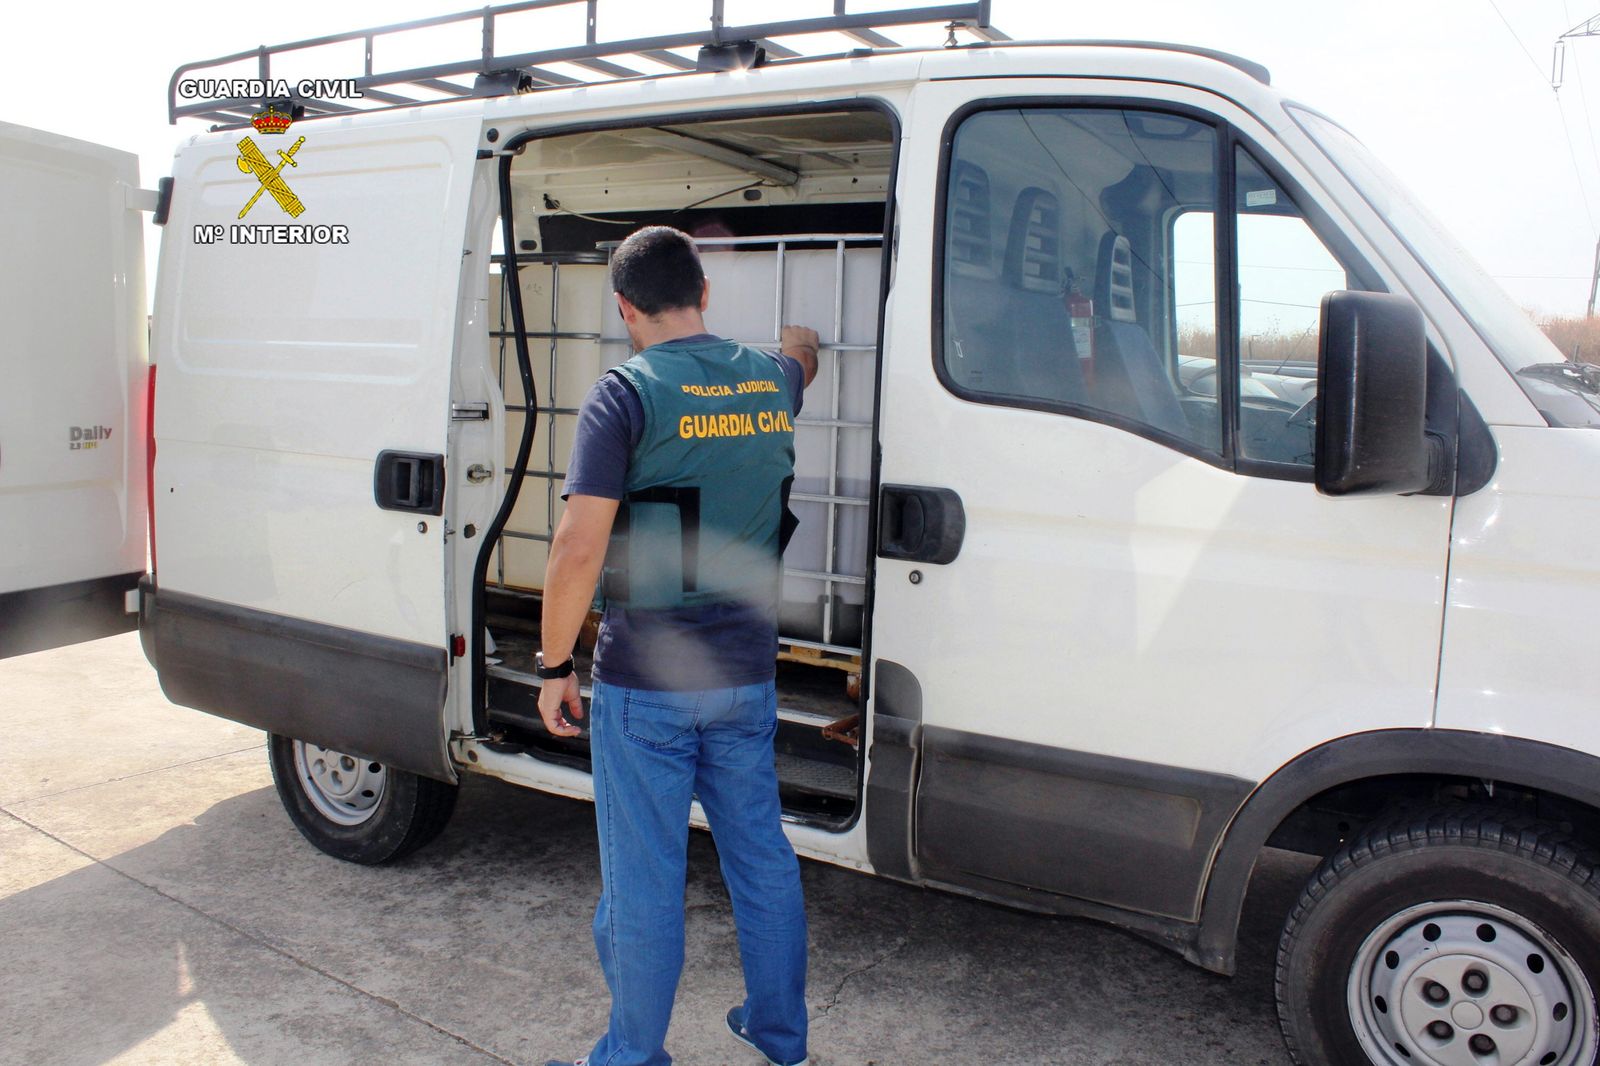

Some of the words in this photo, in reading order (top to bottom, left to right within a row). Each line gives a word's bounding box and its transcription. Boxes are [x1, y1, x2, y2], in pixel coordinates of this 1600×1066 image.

[681, 385, 734, 397] POLICIA
[736, 380, 779, 394] JUDICIAL
[70, 425, 112, 440] Daily
[679, 413, 756, 439] GUARDIA
